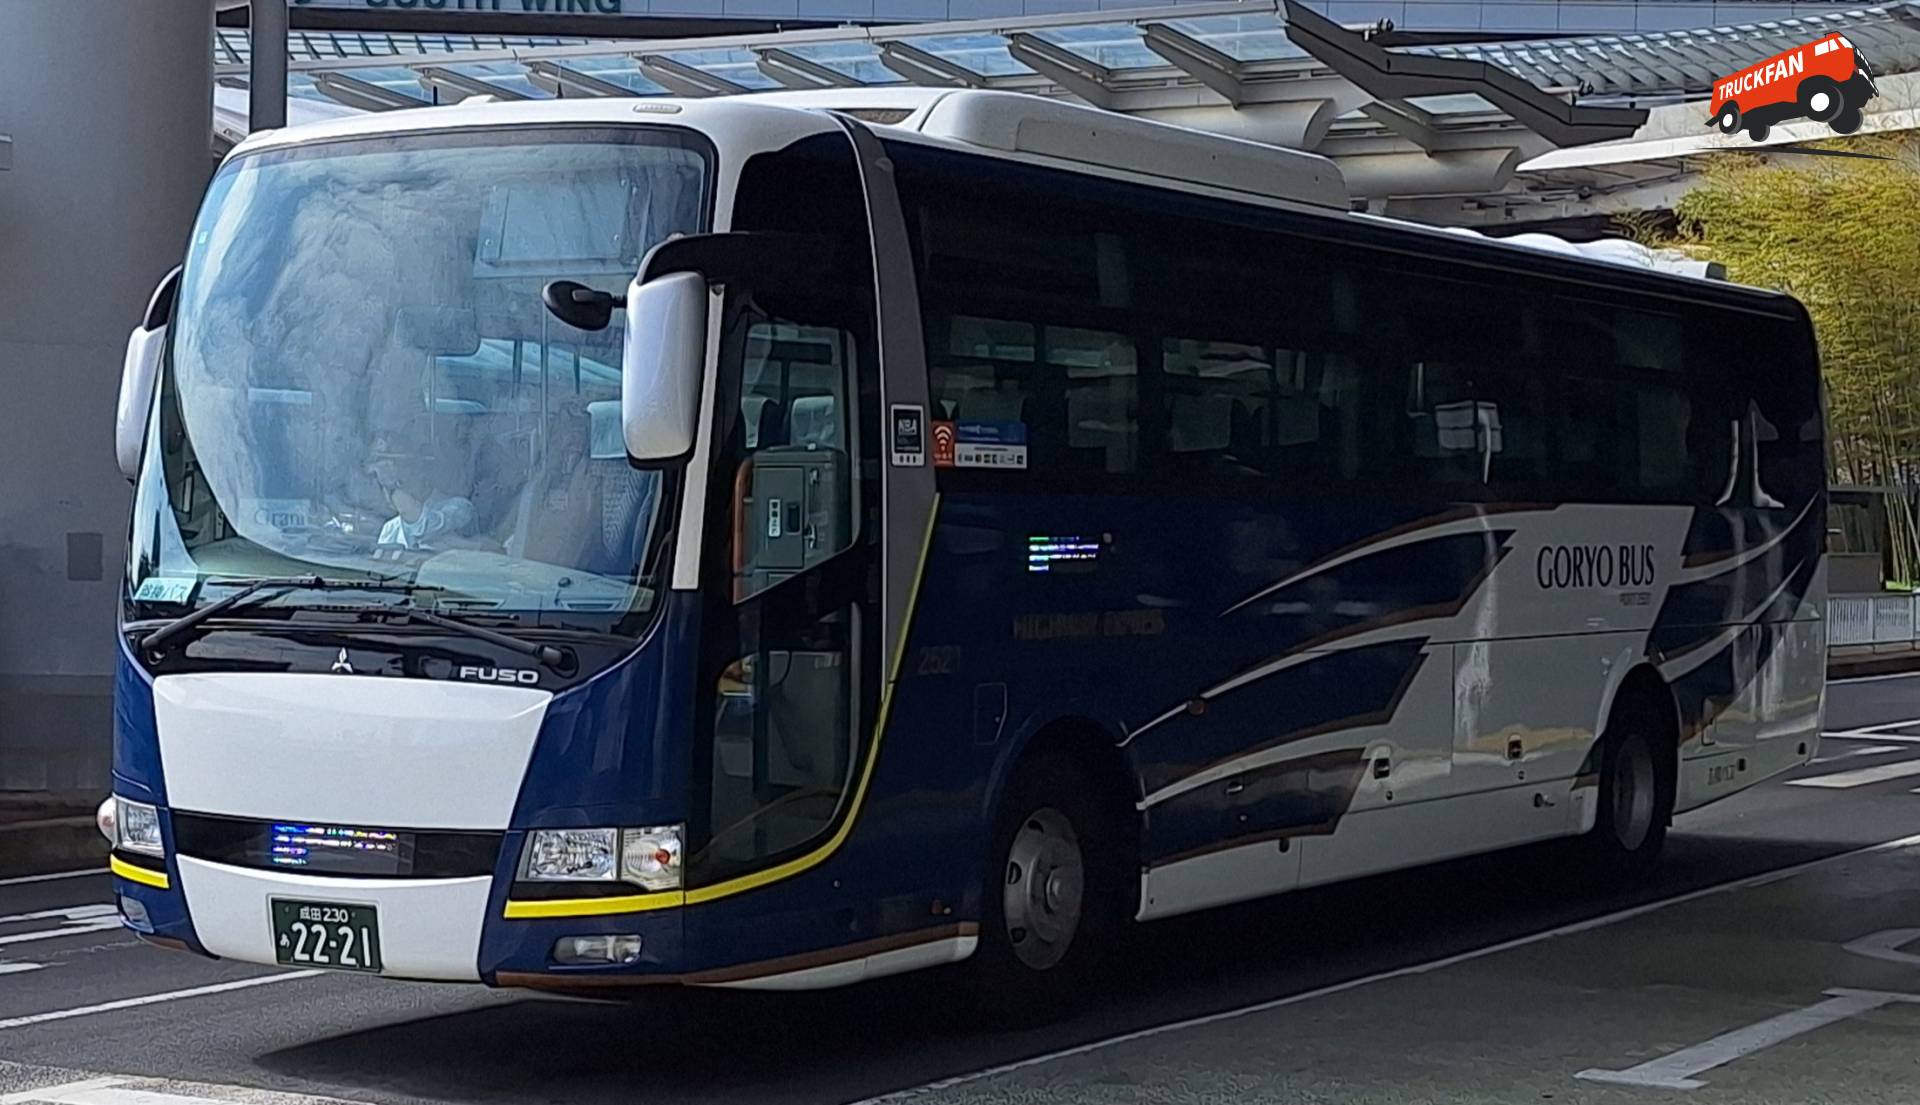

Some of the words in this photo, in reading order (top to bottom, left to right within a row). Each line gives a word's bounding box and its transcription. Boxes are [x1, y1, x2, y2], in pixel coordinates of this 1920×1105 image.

[1537, 545, 1613, 589] GORYO
[1619, 544, 1655, 586] BUS
[460, 665, 539, 684] FUSO
